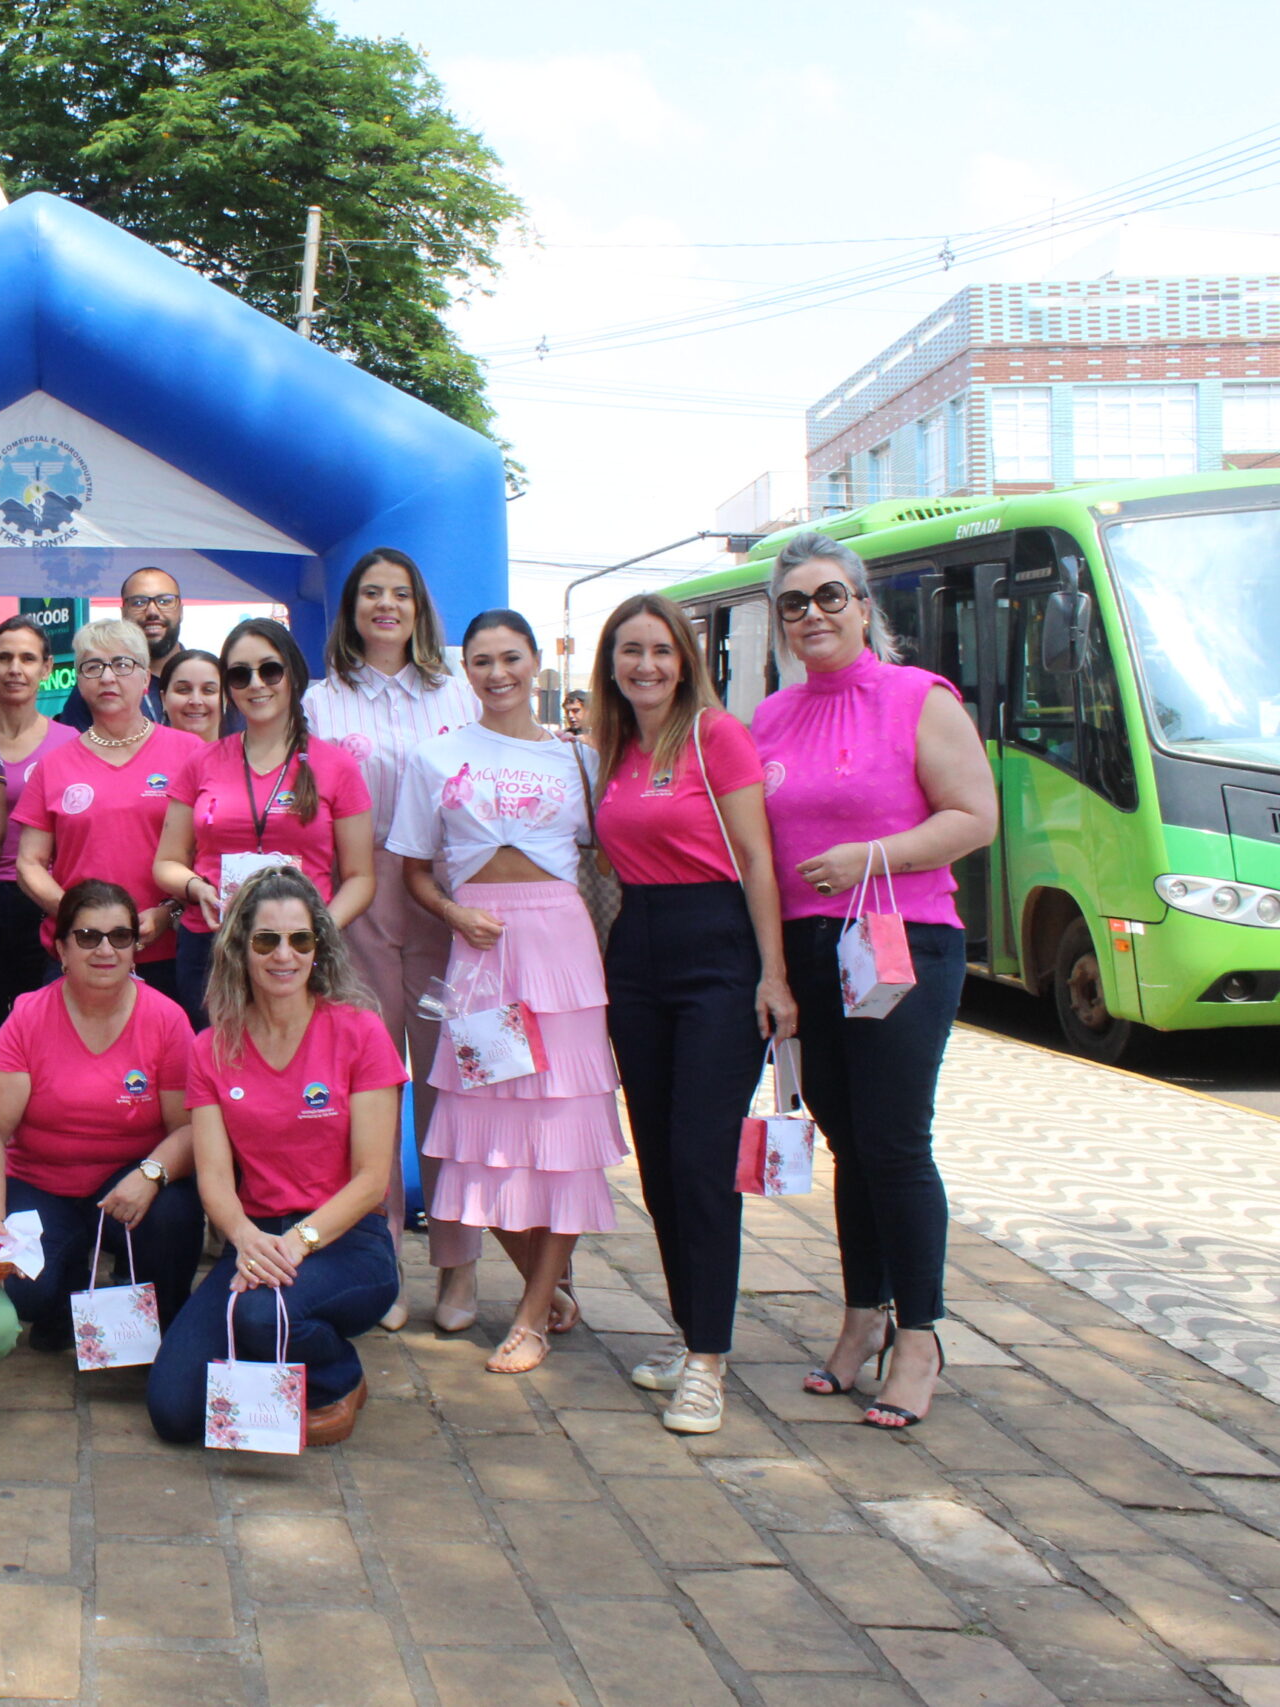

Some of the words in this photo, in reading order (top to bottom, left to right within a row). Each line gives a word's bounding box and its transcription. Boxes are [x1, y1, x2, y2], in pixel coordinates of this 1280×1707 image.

[1, 435, 49, 455] COMERCIAL
[51, 437, 58, 445] E
[32, 527, 79, 548] PONTAS
[955, 518, 1002, 540] ENTRADA
[495, 781, 544, 796] ROSA
